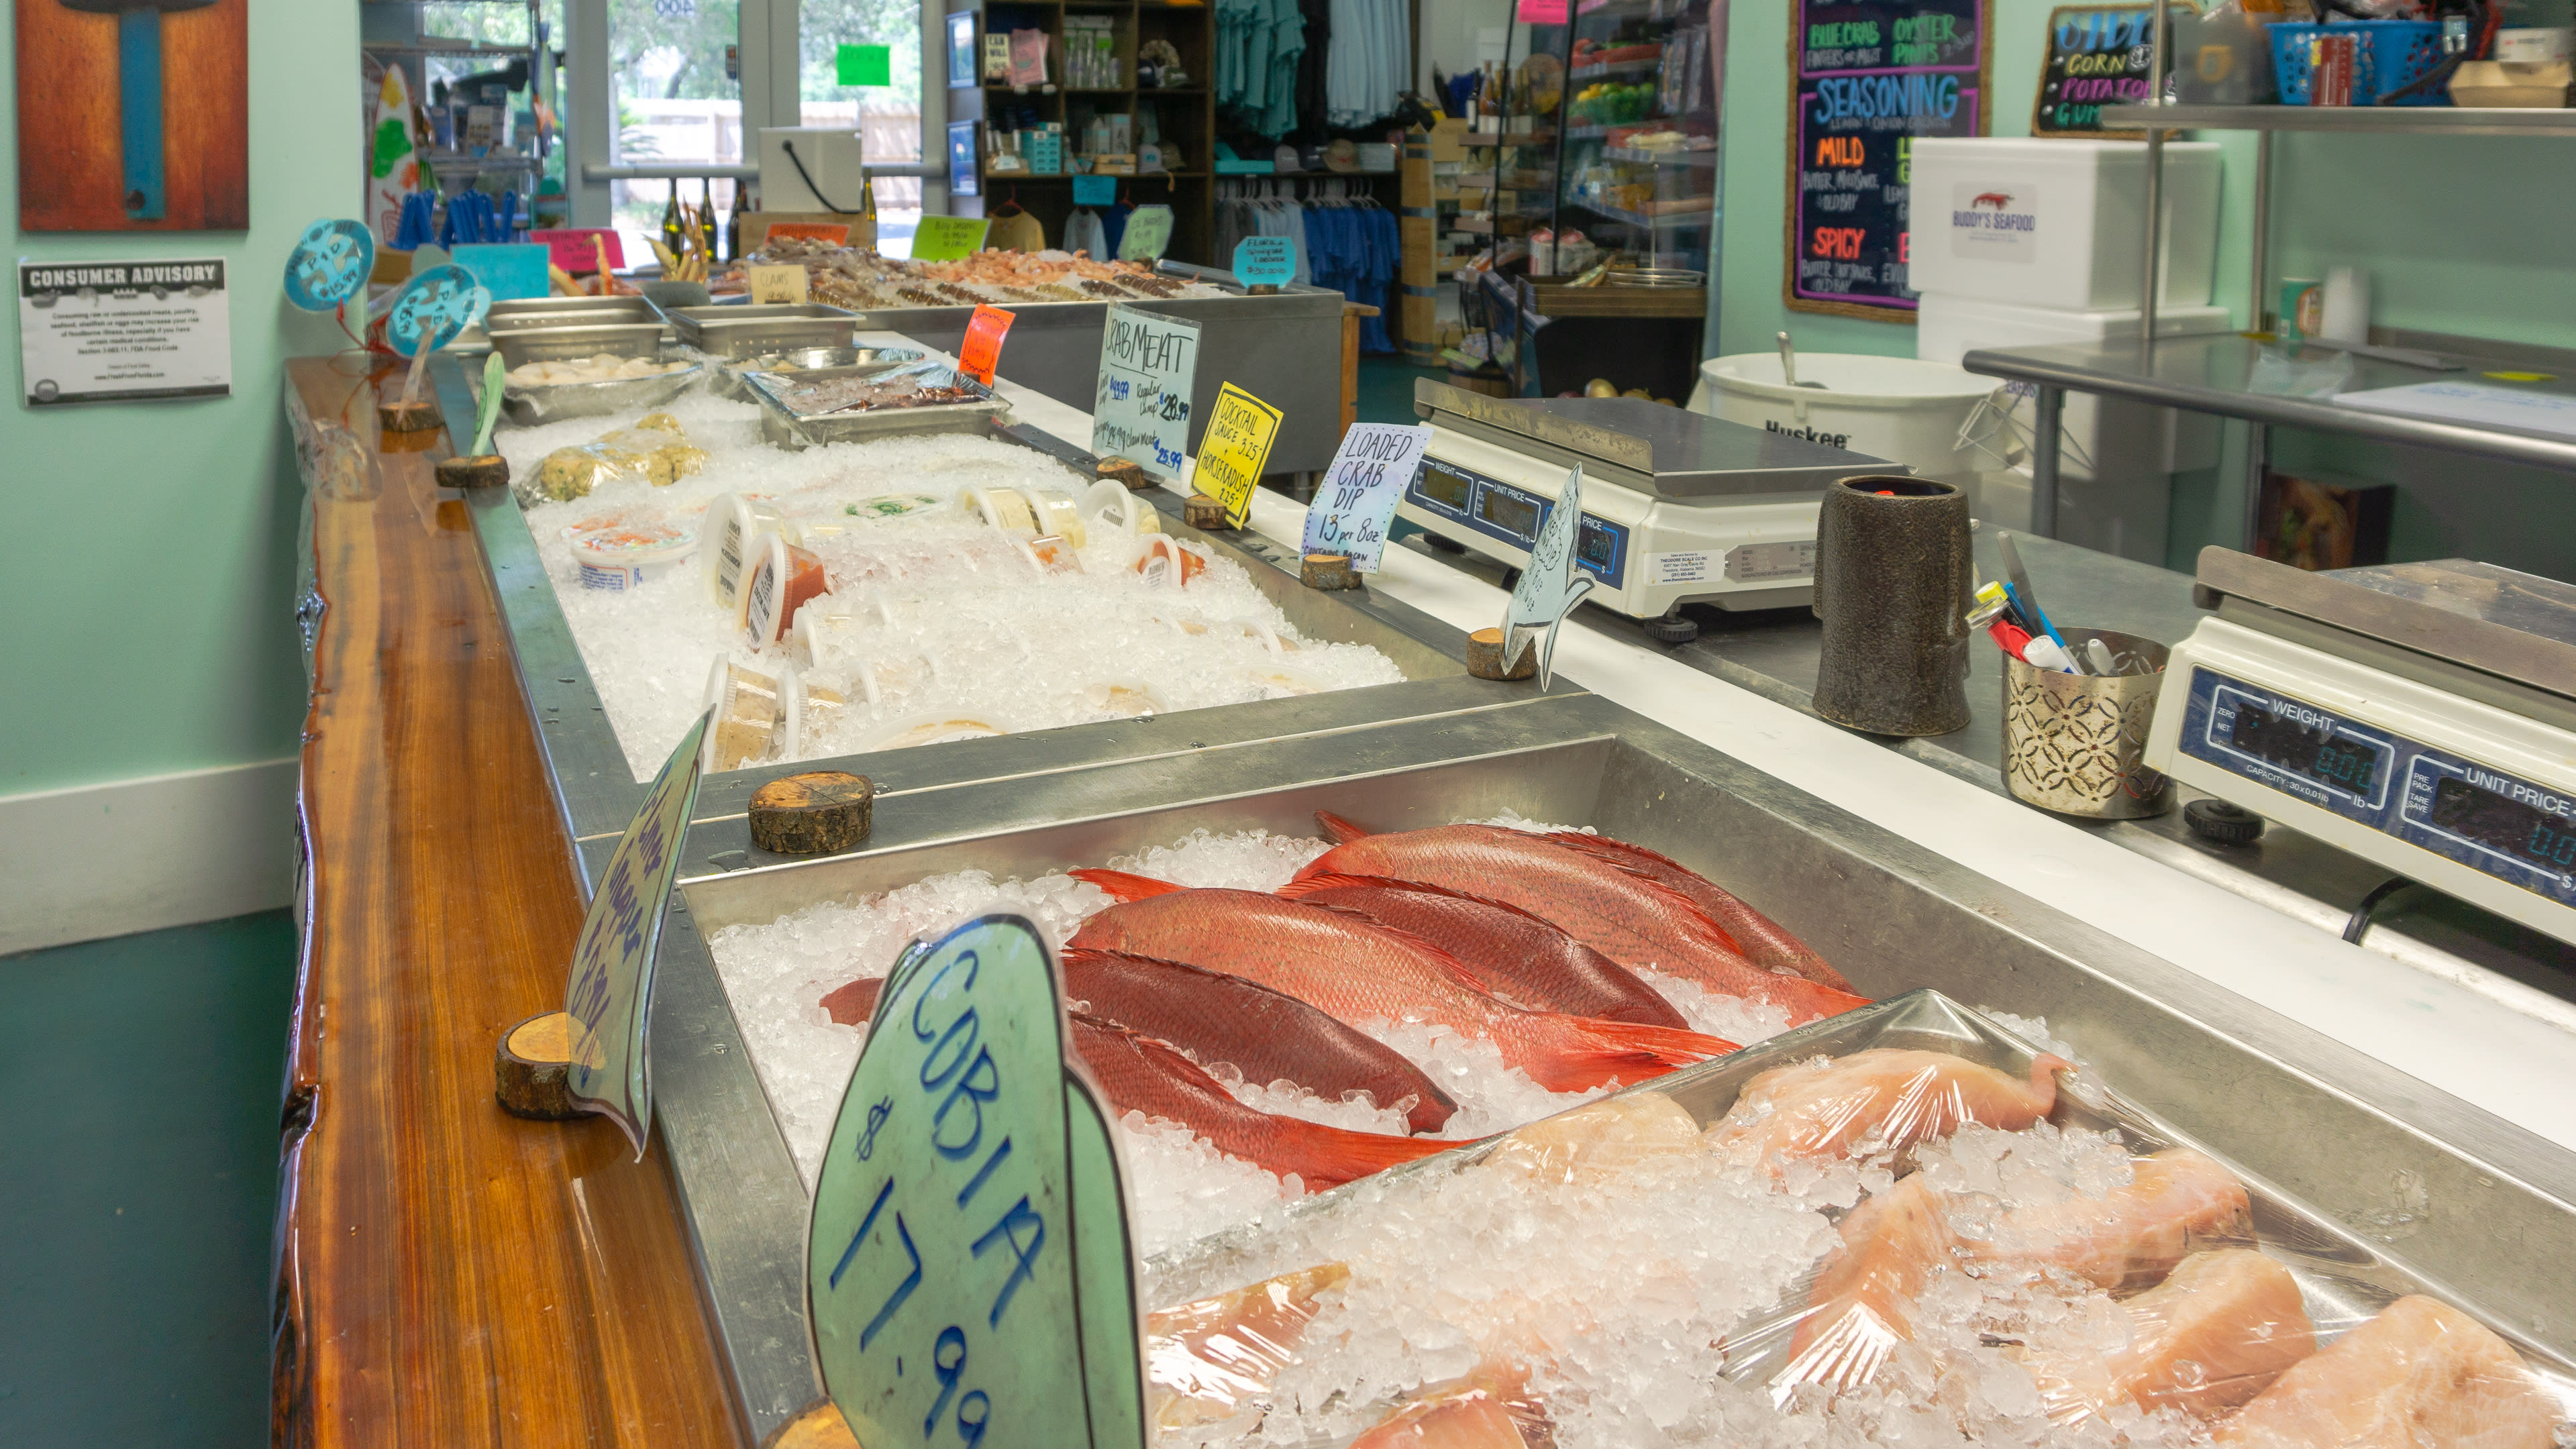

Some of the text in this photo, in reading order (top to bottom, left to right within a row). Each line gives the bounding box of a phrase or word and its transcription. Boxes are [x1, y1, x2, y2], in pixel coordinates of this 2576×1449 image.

[1892, 14, 1958, 43] OYSTER
[2059, 12, 2155, 50] SIDE
[2067, 54, 2127, 74] CORN
[2061, 77, 2151, 100] POTATOE
[1814, 74, 1959, 125] SEASONING
[2055, 102, 2101, 126] GUM
[1816, 136, 1865, 166] MILD
[1953, 210, 2035, 231] BUDDY'S SEAFOOD
[1812, 226, 1866, 260] SPICY
[30, 265, 215, 286] CONSUMER ADVISORY
[760, 272, 788, 286] CLAMS
[1130, 323, 1194, 373] MEAT
[1221, 397, 1258, 436] COCKTAIL
[1215, 421, 1239, 443] SAUCE
[1345, 431, 1412, 462] LOADED
[1200, 449, 1250, 495] HORSERADISH
[1337, 461, 1384, 488] CRAB
[1435, 462, 1455, 476] WEIGHT
[1333, 488, 1365, 511] DIP
[1494, 483, 1525, 502] UNIT PRICE
[1583, 516, 1602, 531] PRICE
[1337, 531, 1354, 545] per
[1343, 549, 1368, 562] BACON
[1601, 566, 1606, 574] $
[2218, 707, 2236, 719] ZERO
[2273, 698, 2334, 731] WEIGHT
[2217, 722, 2230, 733] NET
[2412, 780, 2433, 794] PACK
[2414, 772, 2430, 784] PRE
[2353, 794, 2366, 808] lb
[2410, 792, 2430, 806] TARE
[2467, 767, 2571, 816] UNIT PRICE
[2408, 800, 2428, 814] SAVE
[913, 948, 1046, 1330] COBIA
